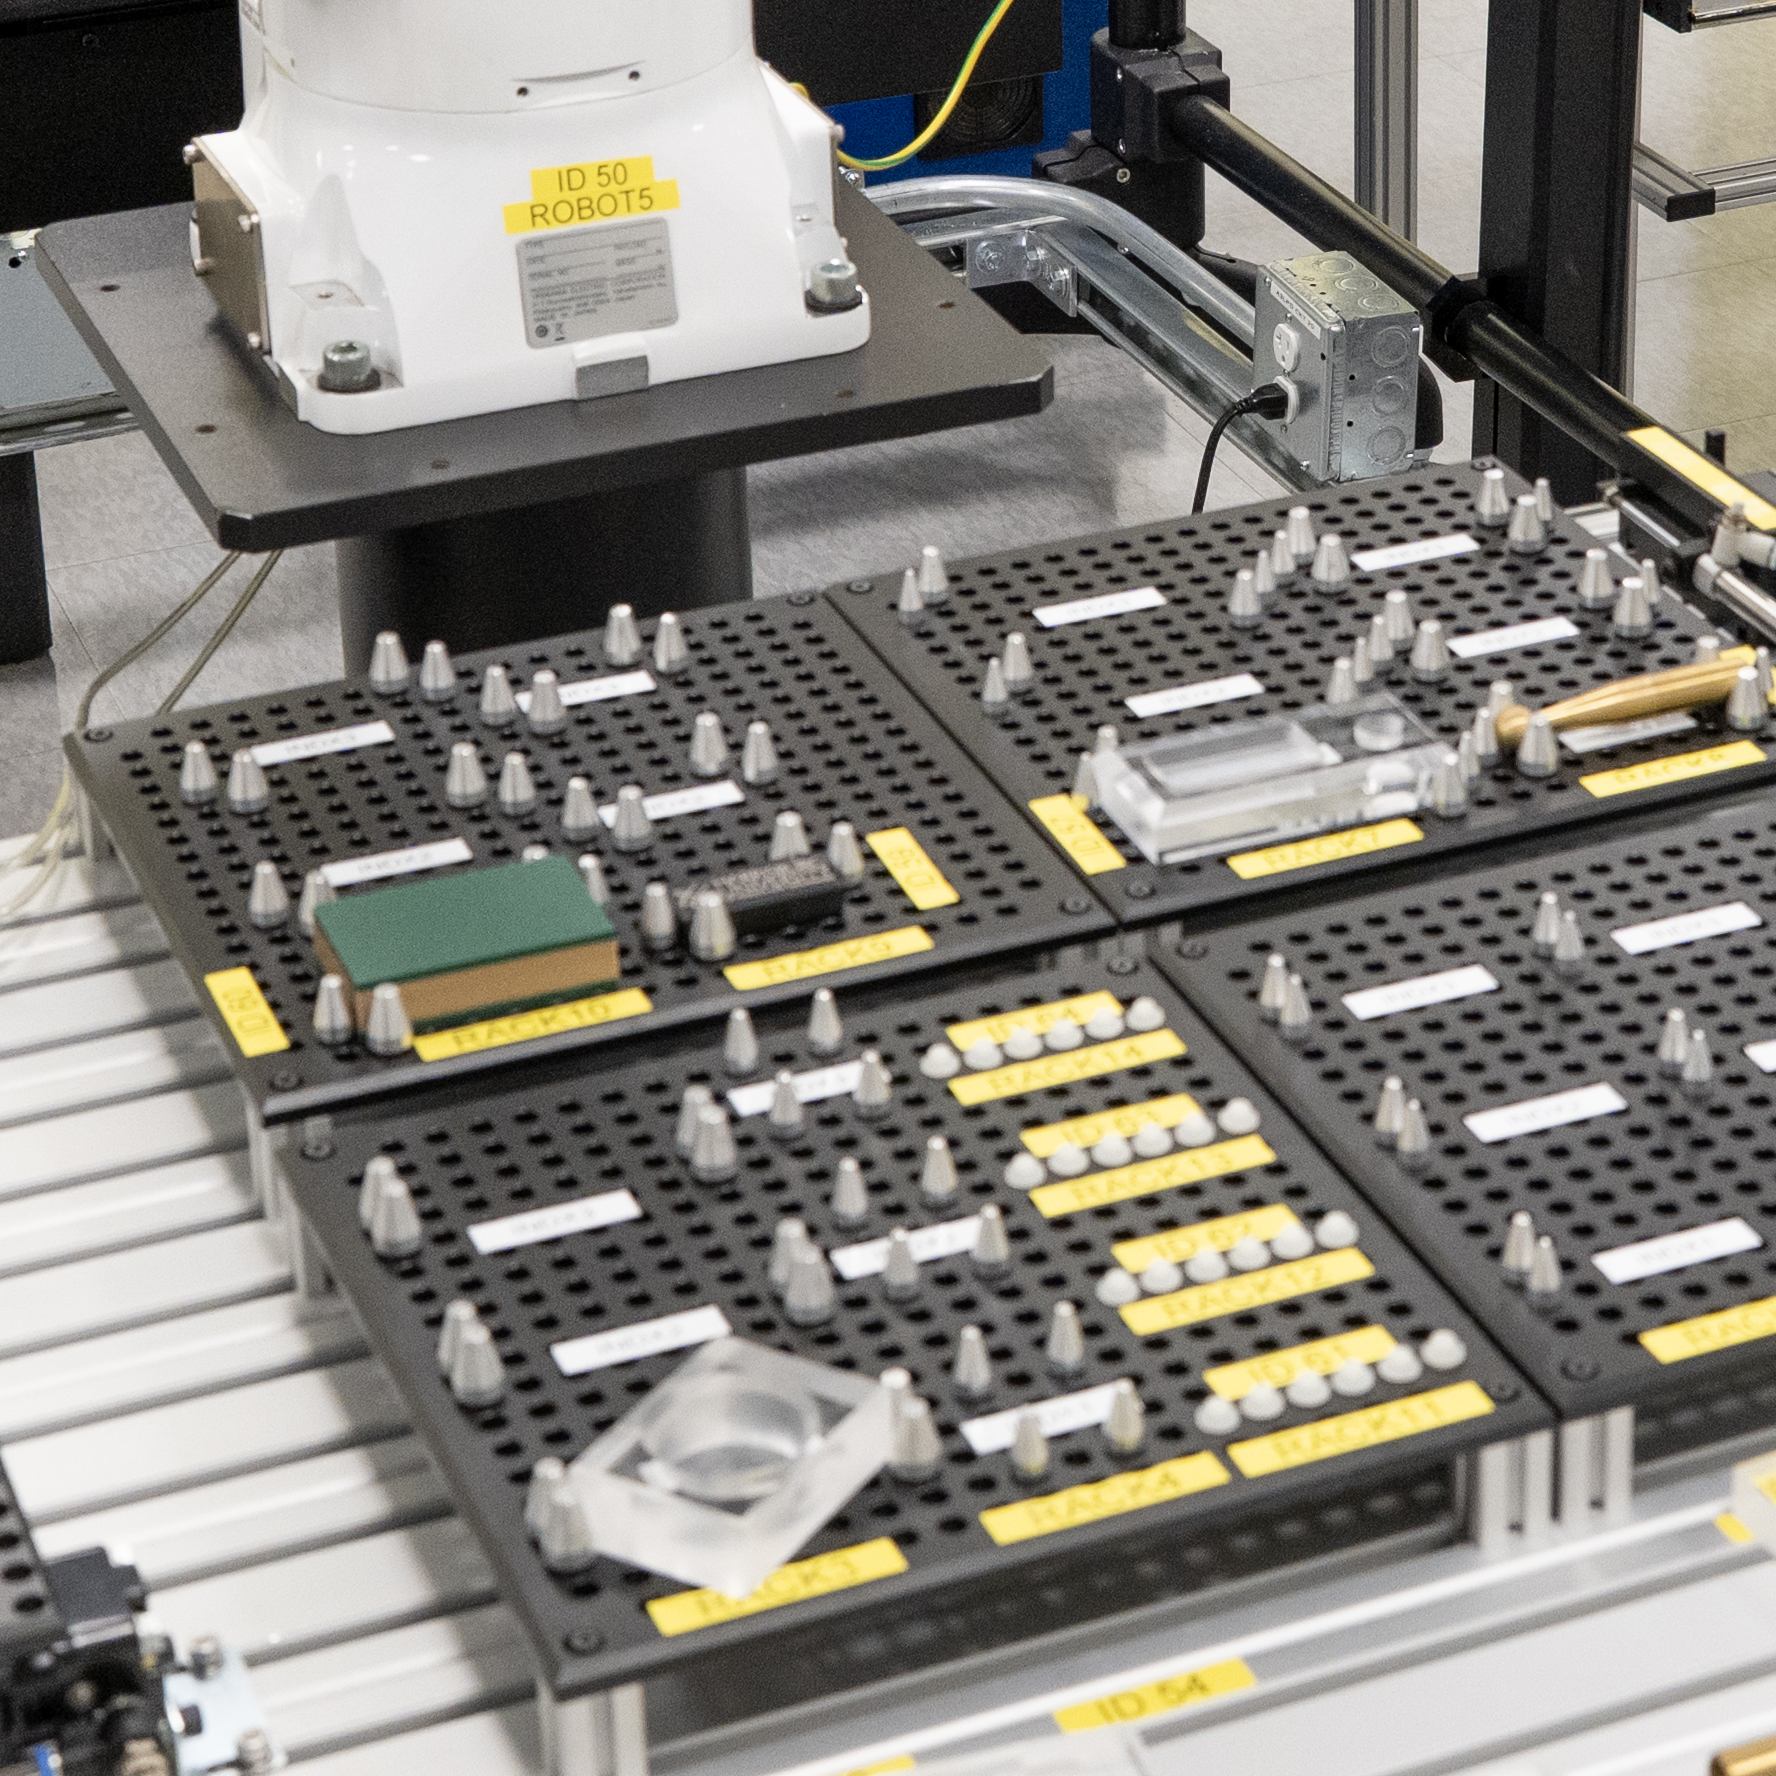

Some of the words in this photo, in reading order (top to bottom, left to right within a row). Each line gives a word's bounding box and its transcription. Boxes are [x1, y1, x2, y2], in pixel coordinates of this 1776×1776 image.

[557, 167, 586, 193] ID
[596, 162, 628, 188] 50
[530, 187, 654, 228] ROBOT5
[455, 1002, 610, 1048] RACK10
[986, 1017, 1020, 1043] ID
[1063, 1121, 1100, 1147] ID
[1155, 1234, 1192, 1261] ID
[1248, 1357, 1287, 1385] ID
[1097, 1688, 1147, 1724] ID
